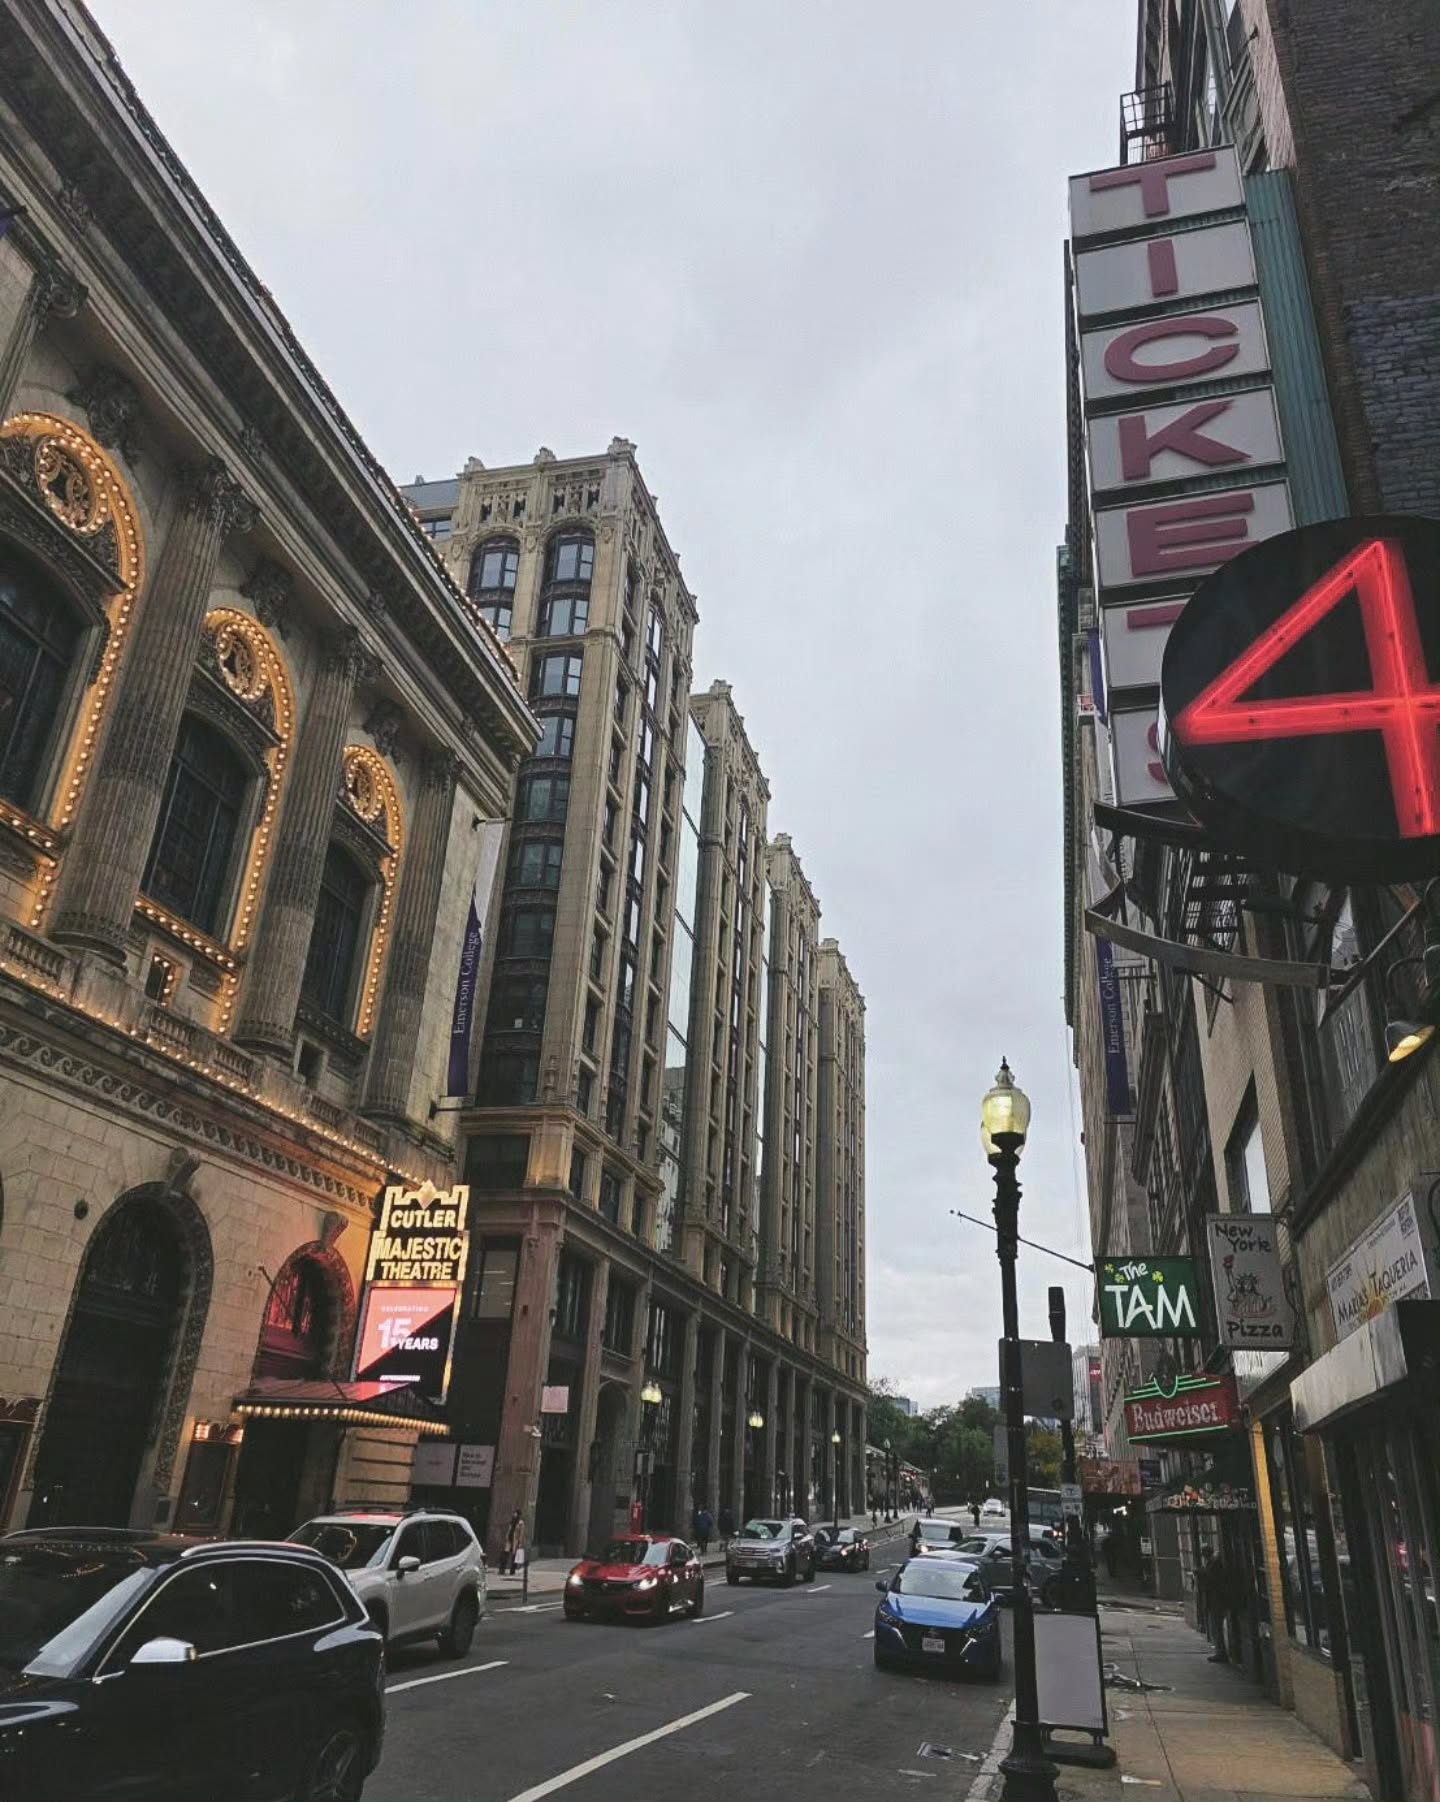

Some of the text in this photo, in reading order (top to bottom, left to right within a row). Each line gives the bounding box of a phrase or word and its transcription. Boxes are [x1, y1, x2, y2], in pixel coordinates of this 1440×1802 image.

[1089, 153, 1261, 785] TICKE
[1174, 536, 1440, 839] 4
[453, 931, 480, 1035] Emerson College
[390, 1209, 457, 1229] CUTLER
[1214, 1222, 1254, 1238] New
[376, 1237, 462, 1261] MAJESTIC
[1227, 1236, 1272, 1253] York
[380, 1261, 453, 1281] THEATRE
[1118, 1261, 1149, 1281] The
[1104, 1284, 1197, 1330] TAM
[377, 1317, 412, 1350] 15
[1226, 1318, 1284, 1339] Pizza
[398, 1337, 439, 1351] YEARS
[1132, 1400, 1219, 1432] Budweiser
